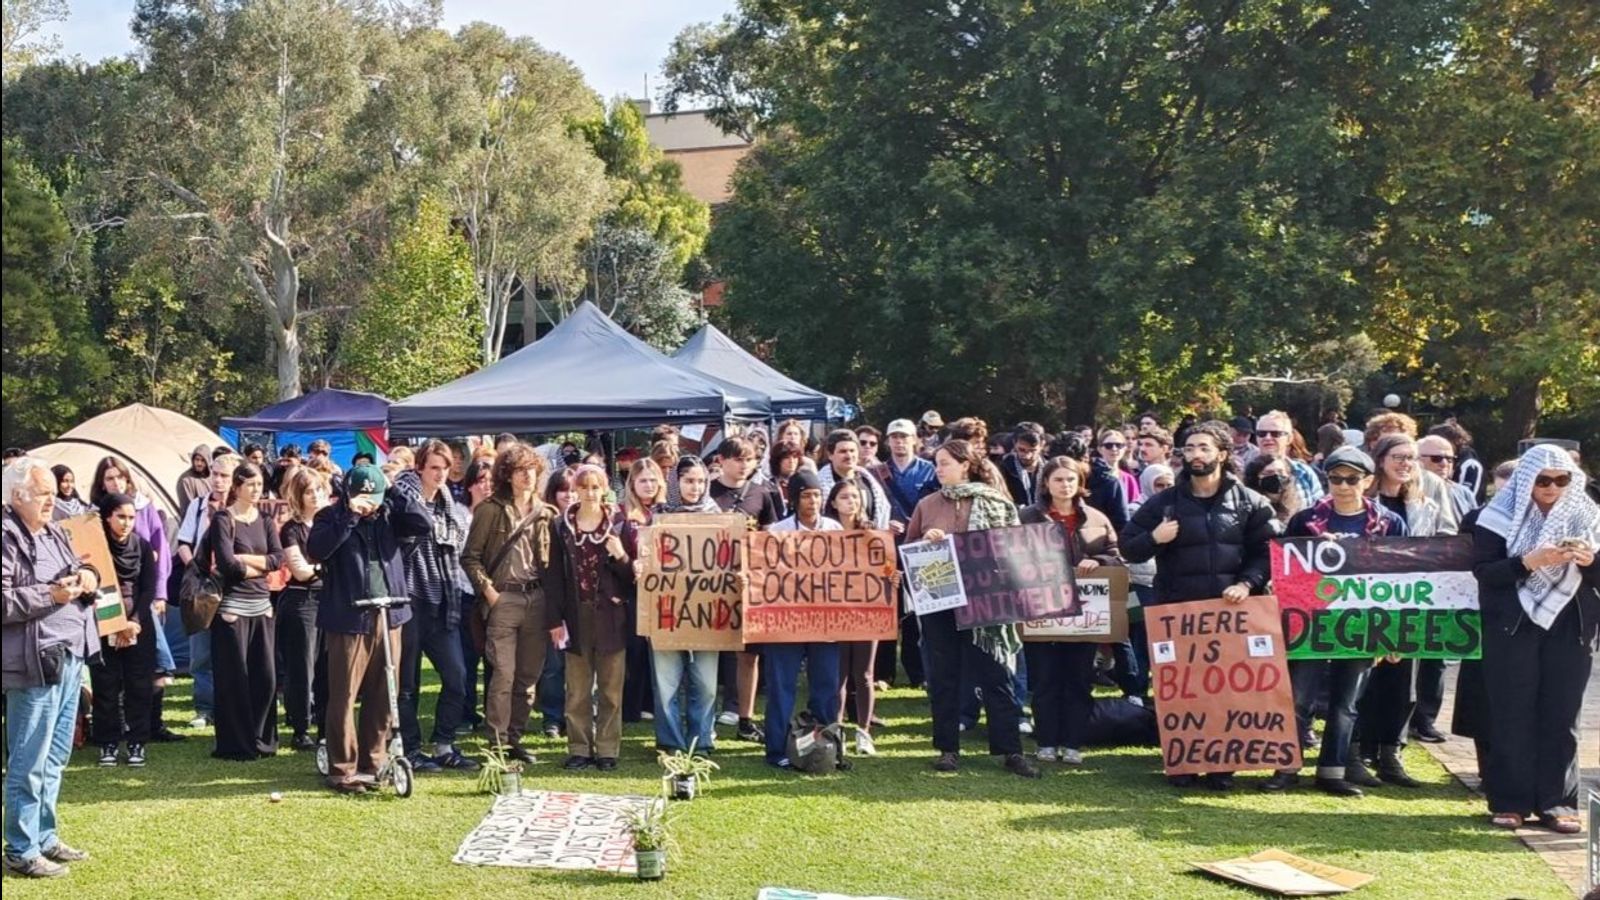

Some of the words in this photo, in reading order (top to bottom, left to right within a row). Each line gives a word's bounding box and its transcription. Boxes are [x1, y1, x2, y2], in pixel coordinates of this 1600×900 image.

[661, 532, 742, 574] BLOOD
[747, 533, 864, 571] LOCKOUT
[1282, 541, 1347, 576] NO
[644, 573, 677, 592] ON
[746, 571, 882, 605] LOCKHEED
[1078, 584, 1110, 597] NDING
[1316, 577, 1367, 602] ON
[1370, 580, 1434, 606] OUR
[657, 595, 742, 632] HANDS
[1160, 610, 1249, 638] THERE
[1282, 606, 1482, 654] DEGREES
[1188, 639, 1221, 664] IS
[1158, 661, 1281, 701] BLOOD
[1163, 711, 1206, 731] ON
[1225, 711, 1285, 733] YOUR
[1166, 737, 1297, 768] DEGREES
